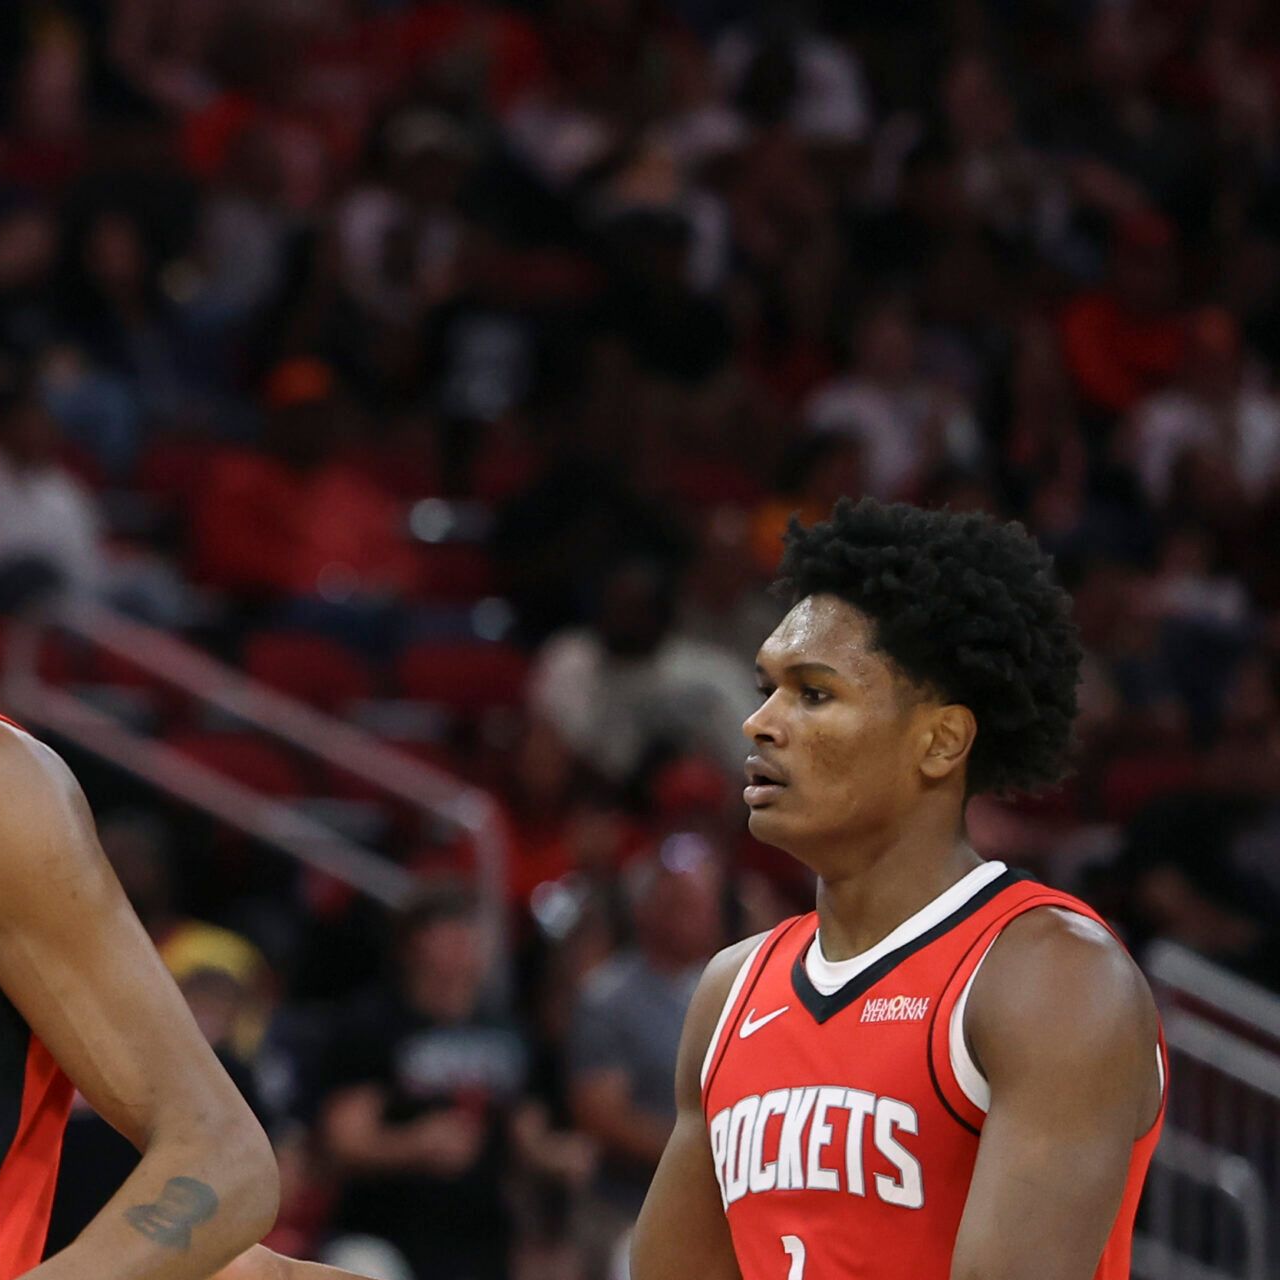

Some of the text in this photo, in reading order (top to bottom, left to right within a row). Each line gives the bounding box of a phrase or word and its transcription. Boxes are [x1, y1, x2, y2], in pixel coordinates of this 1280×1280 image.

[864, 995, 930, 1011] MEMORIAL
[860, 1007, 928, 1022] HERMANN
[710, 1085, 924, 1213] ROCKETS
